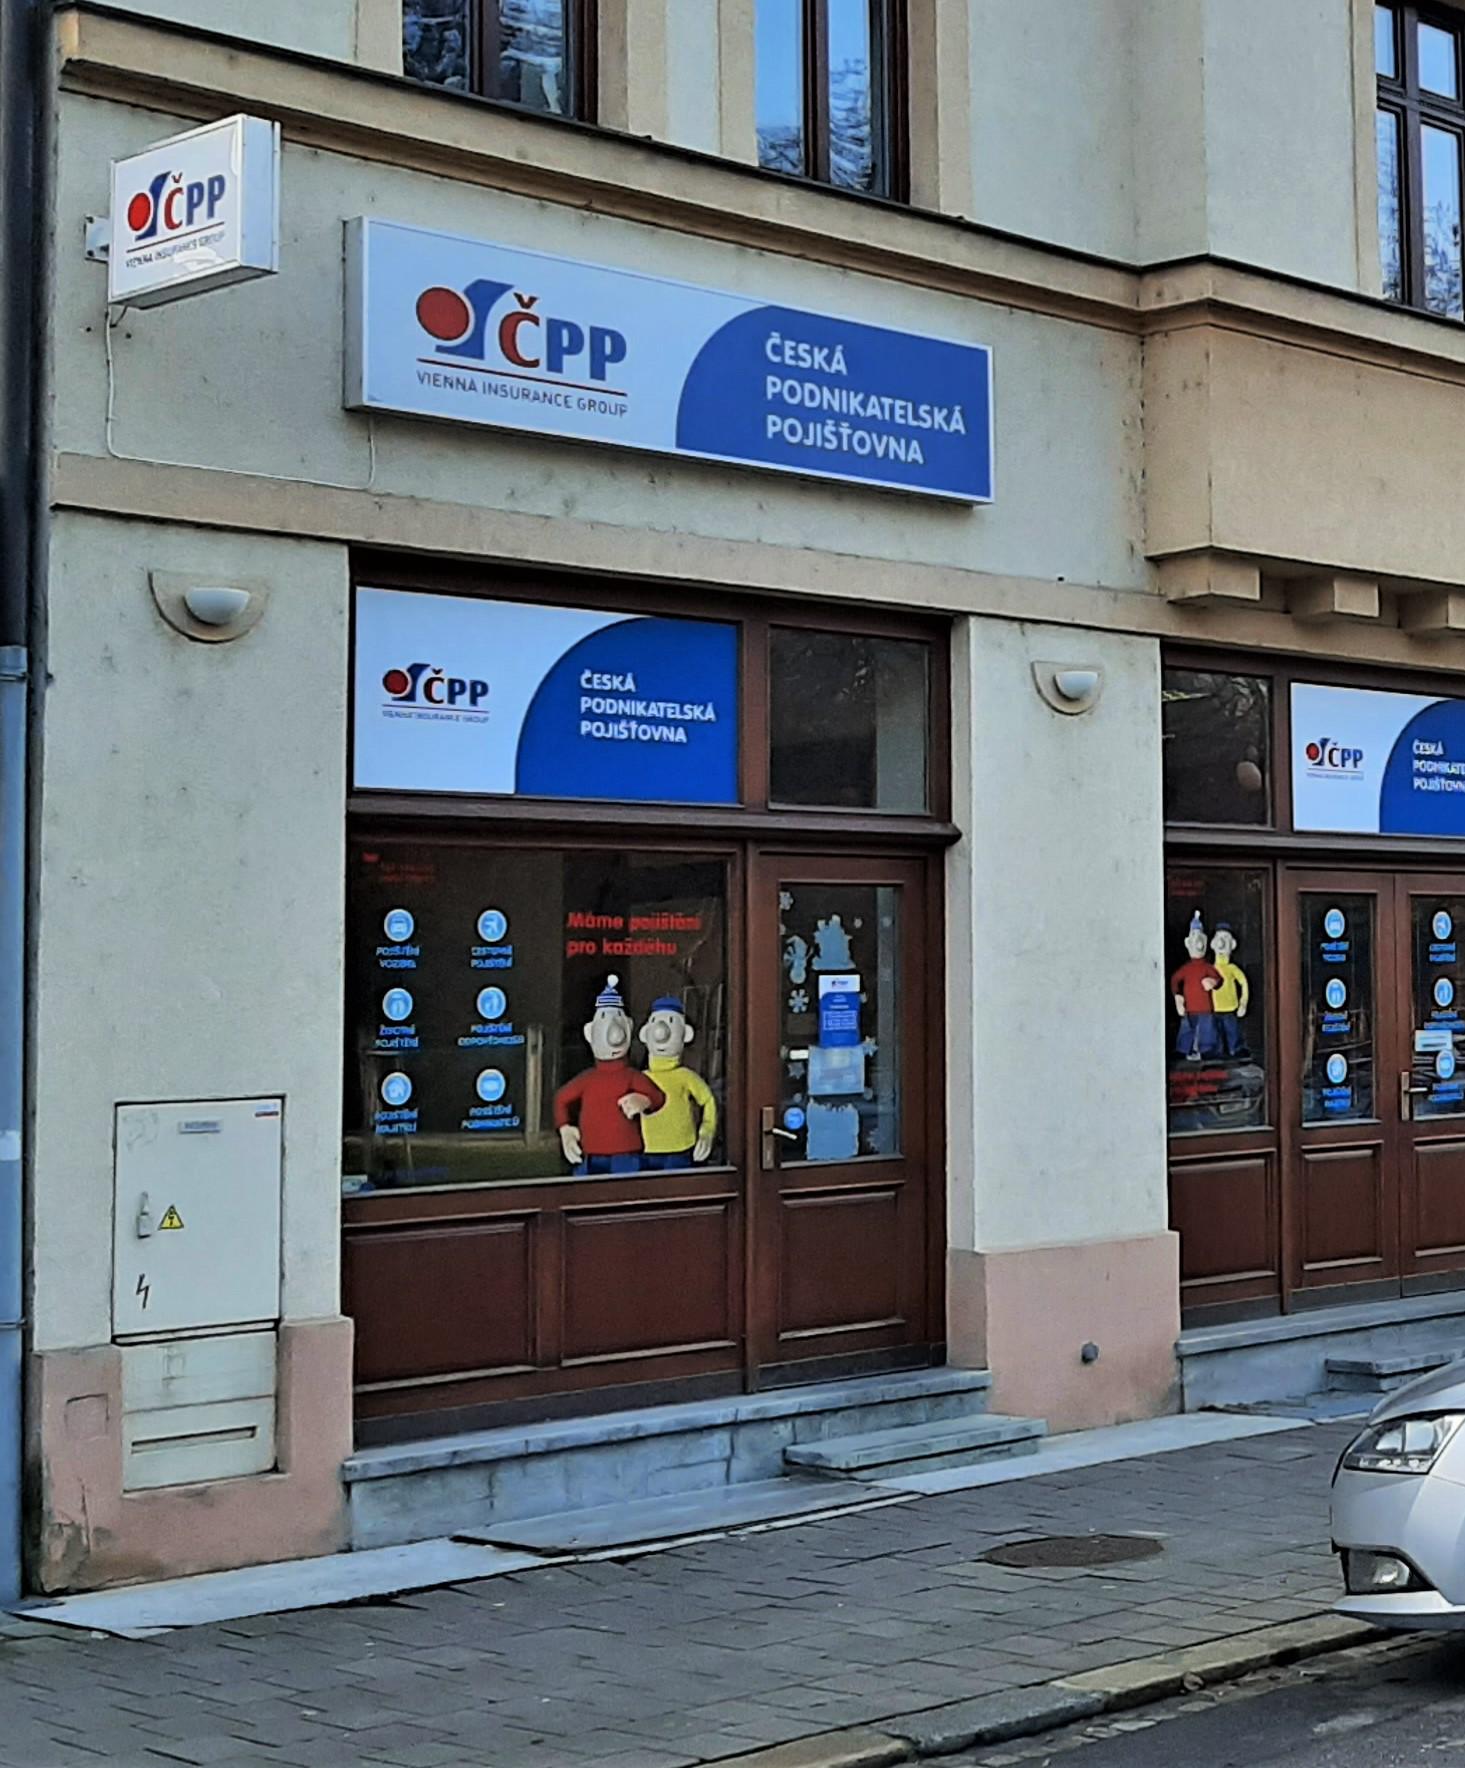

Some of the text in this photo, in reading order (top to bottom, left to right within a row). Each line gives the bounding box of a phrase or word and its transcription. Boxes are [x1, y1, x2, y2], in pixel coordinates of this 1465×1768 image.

[164, 172, 225, 230] ČPP
[498, 292, 627, 381] ČPP
[765, 331, 848, 376] ČESKÁ
[417, 370, 628, 418] VIENNA INSURANCE GROUP
[766, 375, 967, 435] PODNIKATELSKÁ
[766, 414, 925, 465] POJIŠŤOVNA
[423, 667, 490, 706] ČPP
[580, 669, 636, 692] ČESKÁ
[580, 696, 716, 722] PODNIKATELSKÁ
[580, 720, 687, 743] POJIŠŤOVNA
[1328, 741, 1364, 769] ČPP
[566, 938, 598, 959] pro
